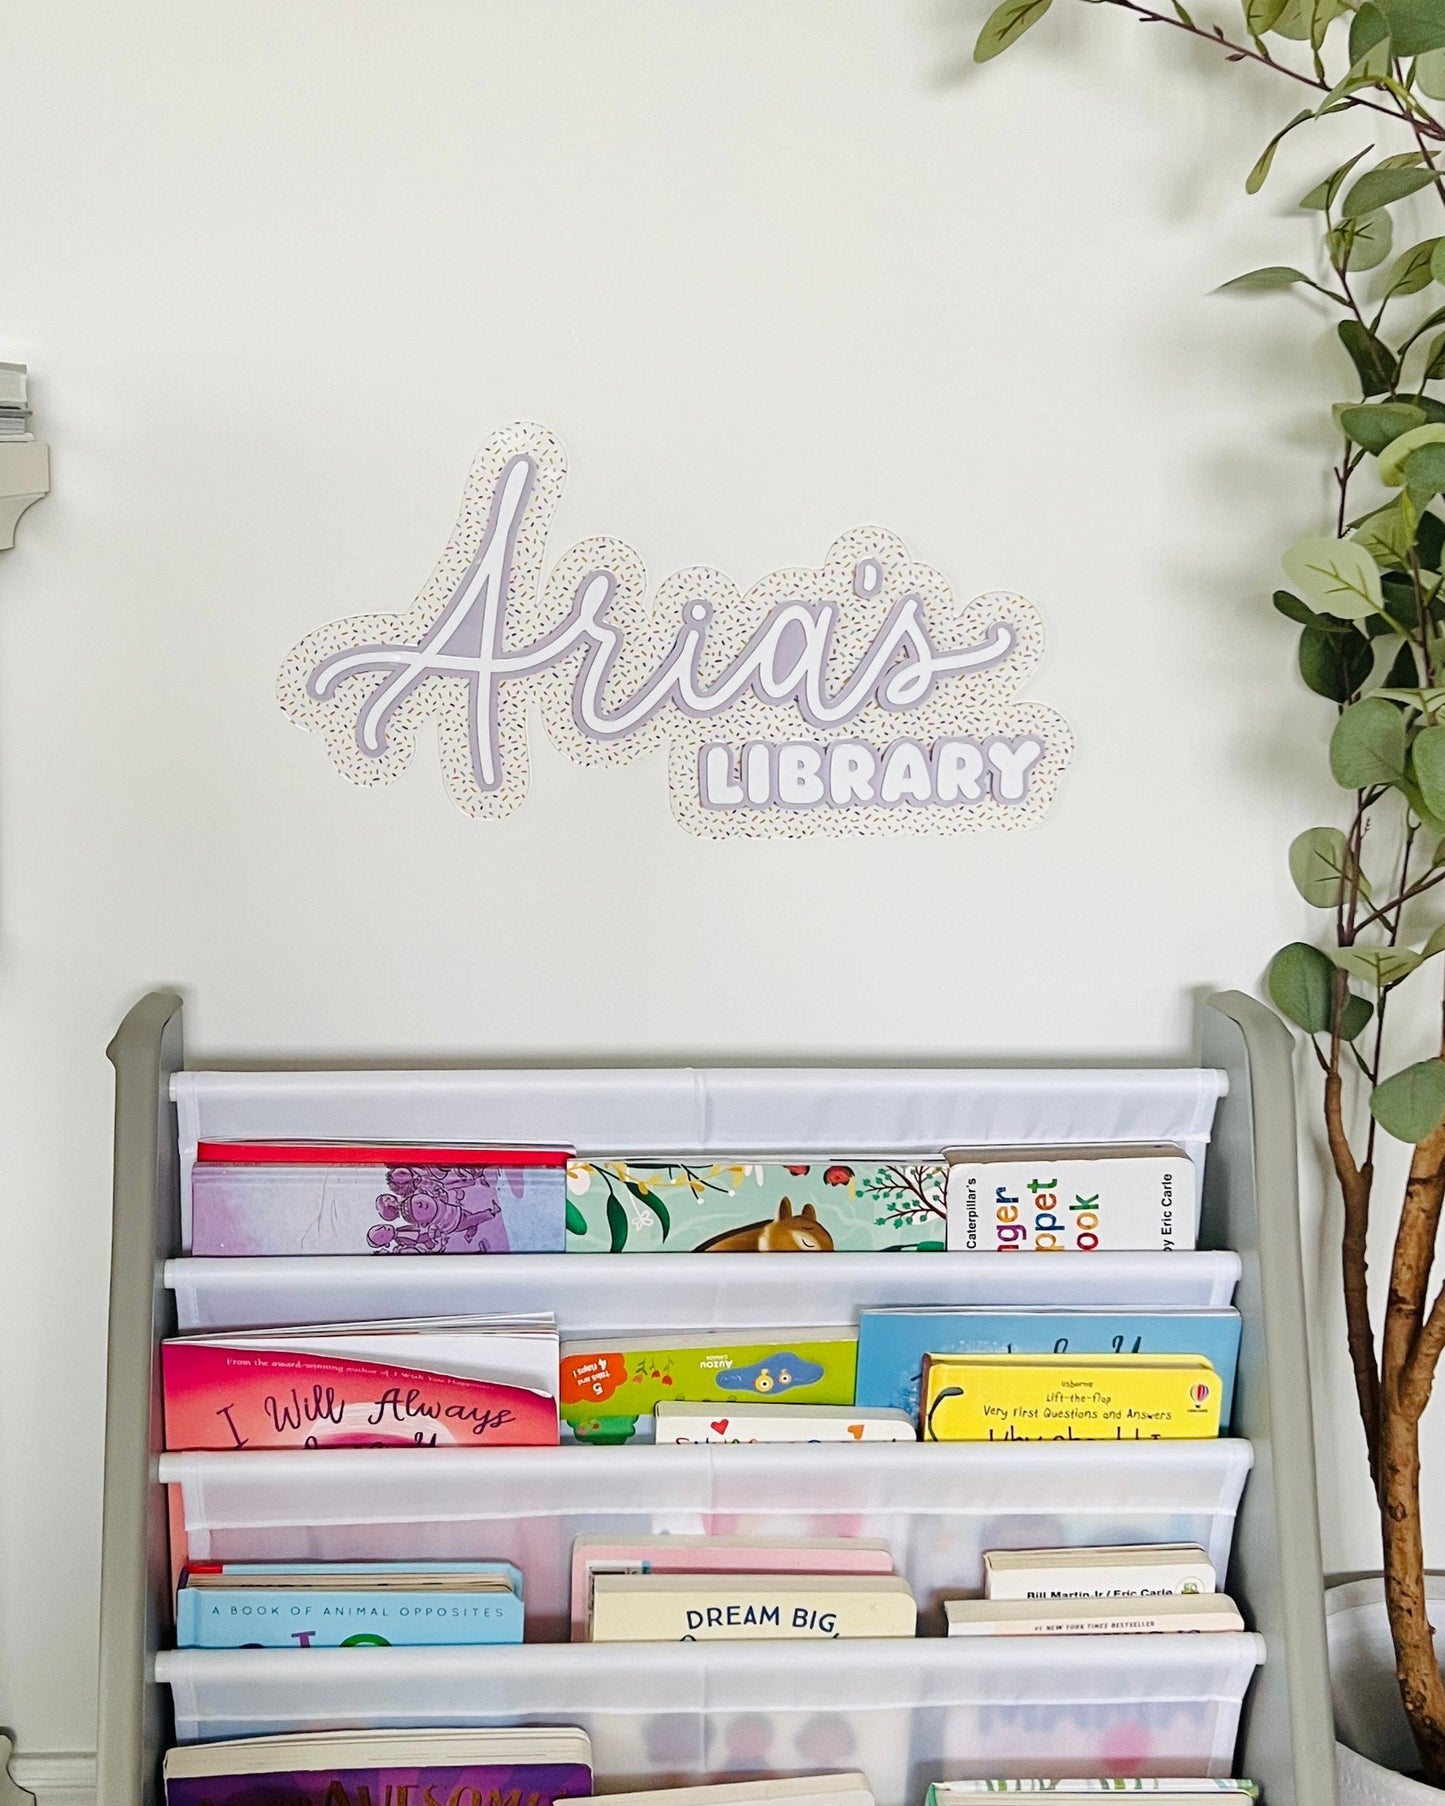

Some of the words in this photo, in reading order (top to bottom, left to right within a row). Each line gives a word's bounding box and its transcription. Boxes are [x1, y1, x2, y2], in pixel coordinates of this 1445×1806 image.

[308, 453, 1020, 791] Aria's
[700, 737, 1042, 808] LIBRARY
[1161, 1173, 1172, 1207] Carle
[966, 1177, 977, 1249] Caterpillar's
[1069, 1193, 1099, 1250] ook
[1161, 1210, 1172, 1235] Eric
[226, 1357, 251, 1366] From
[254, 1358, 269, 1367] the
[271, 1360, 344, 1373] award-winning
[598, 1358, 607, 1371] 4
[592, 1382, 604, 1395] 5
[216, 1403, 249, 1449] I
[264, 1384, 345, 1432] Will
[367, 1388, 517, 1435] Always
[983, 1405, 1008, 1420] Very
[1013, 1406, 1038, 1418] First
[1043, 1407, 1098, 1419] Questions
[1103, 1410, 1122, 1419] and
[1126, 1408, 1172, 1420] Answers
[212, 1606, 220, 1615] A
[230, 1606, 280, 1616] BOOK
[290, 1606, 312, 1616] OF
[323, 1606, 389, 1617] ANIMAL
[400, 1606, 504, 1617] OPPOSITES
[686, 1605, 780, 1630] DREAM
